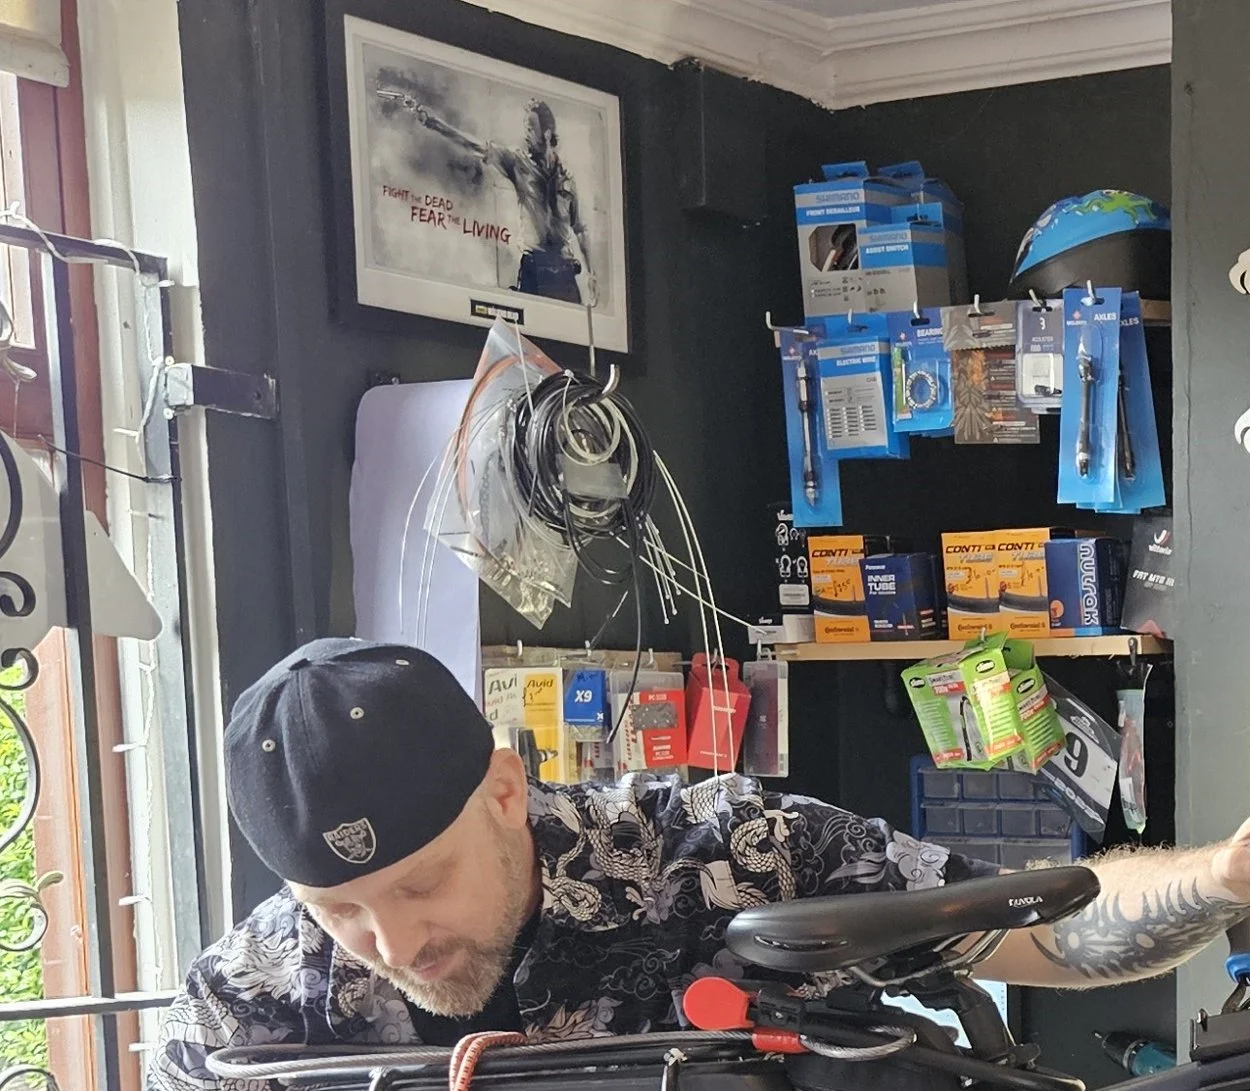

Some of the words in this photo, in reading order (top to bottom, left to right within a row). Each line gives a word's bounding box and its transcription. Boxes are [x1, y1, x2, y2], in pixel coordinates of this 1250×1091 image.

[383, 185, 410, 201] FIGHT
[425, 195, 454, 212] DEAD
[816, 192, 860, 202] SHIMANO
[411, 206, 447, 230] FEAR
[463, 218, 511, 244] LIVING
[1094, 312, 1117, 322] AXLES
[945, 545, 981, 554] CONTI
[998, 542, 1034, 551] CONTI
[811, 548, 848, 558] CONTI
[867, 574, 896, 582] INNER
[868, 582, 896, 591] TUBE
[527, 679, 553, 688] Avid
[574, 690, 593, 703] X9
[1060, 732, 1088, 778] 9
[327, 821, 367, 841] RAIDERS
